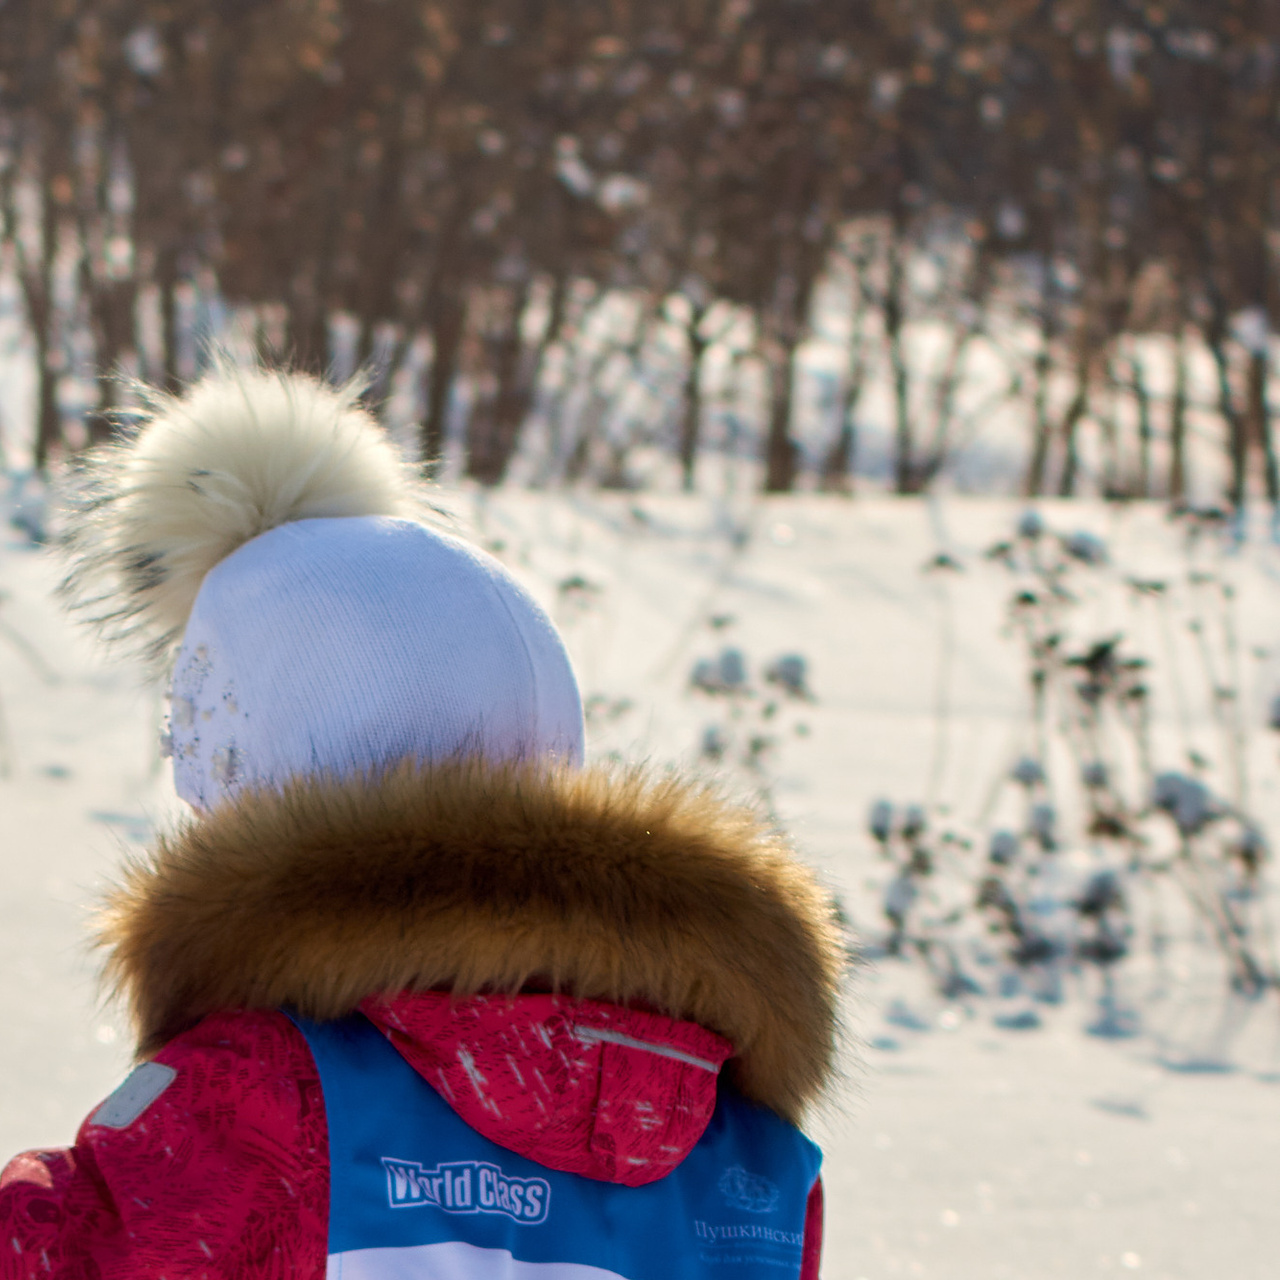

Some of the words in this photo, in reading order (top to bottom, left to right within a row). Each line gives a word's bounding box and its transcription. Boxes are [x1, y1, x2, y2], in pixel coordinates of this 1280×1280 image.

[388, 1164, 471, 1208] World
[479, 1168, 543, 1217] Class
[695, 1220, 805, 1247] Пушкински
